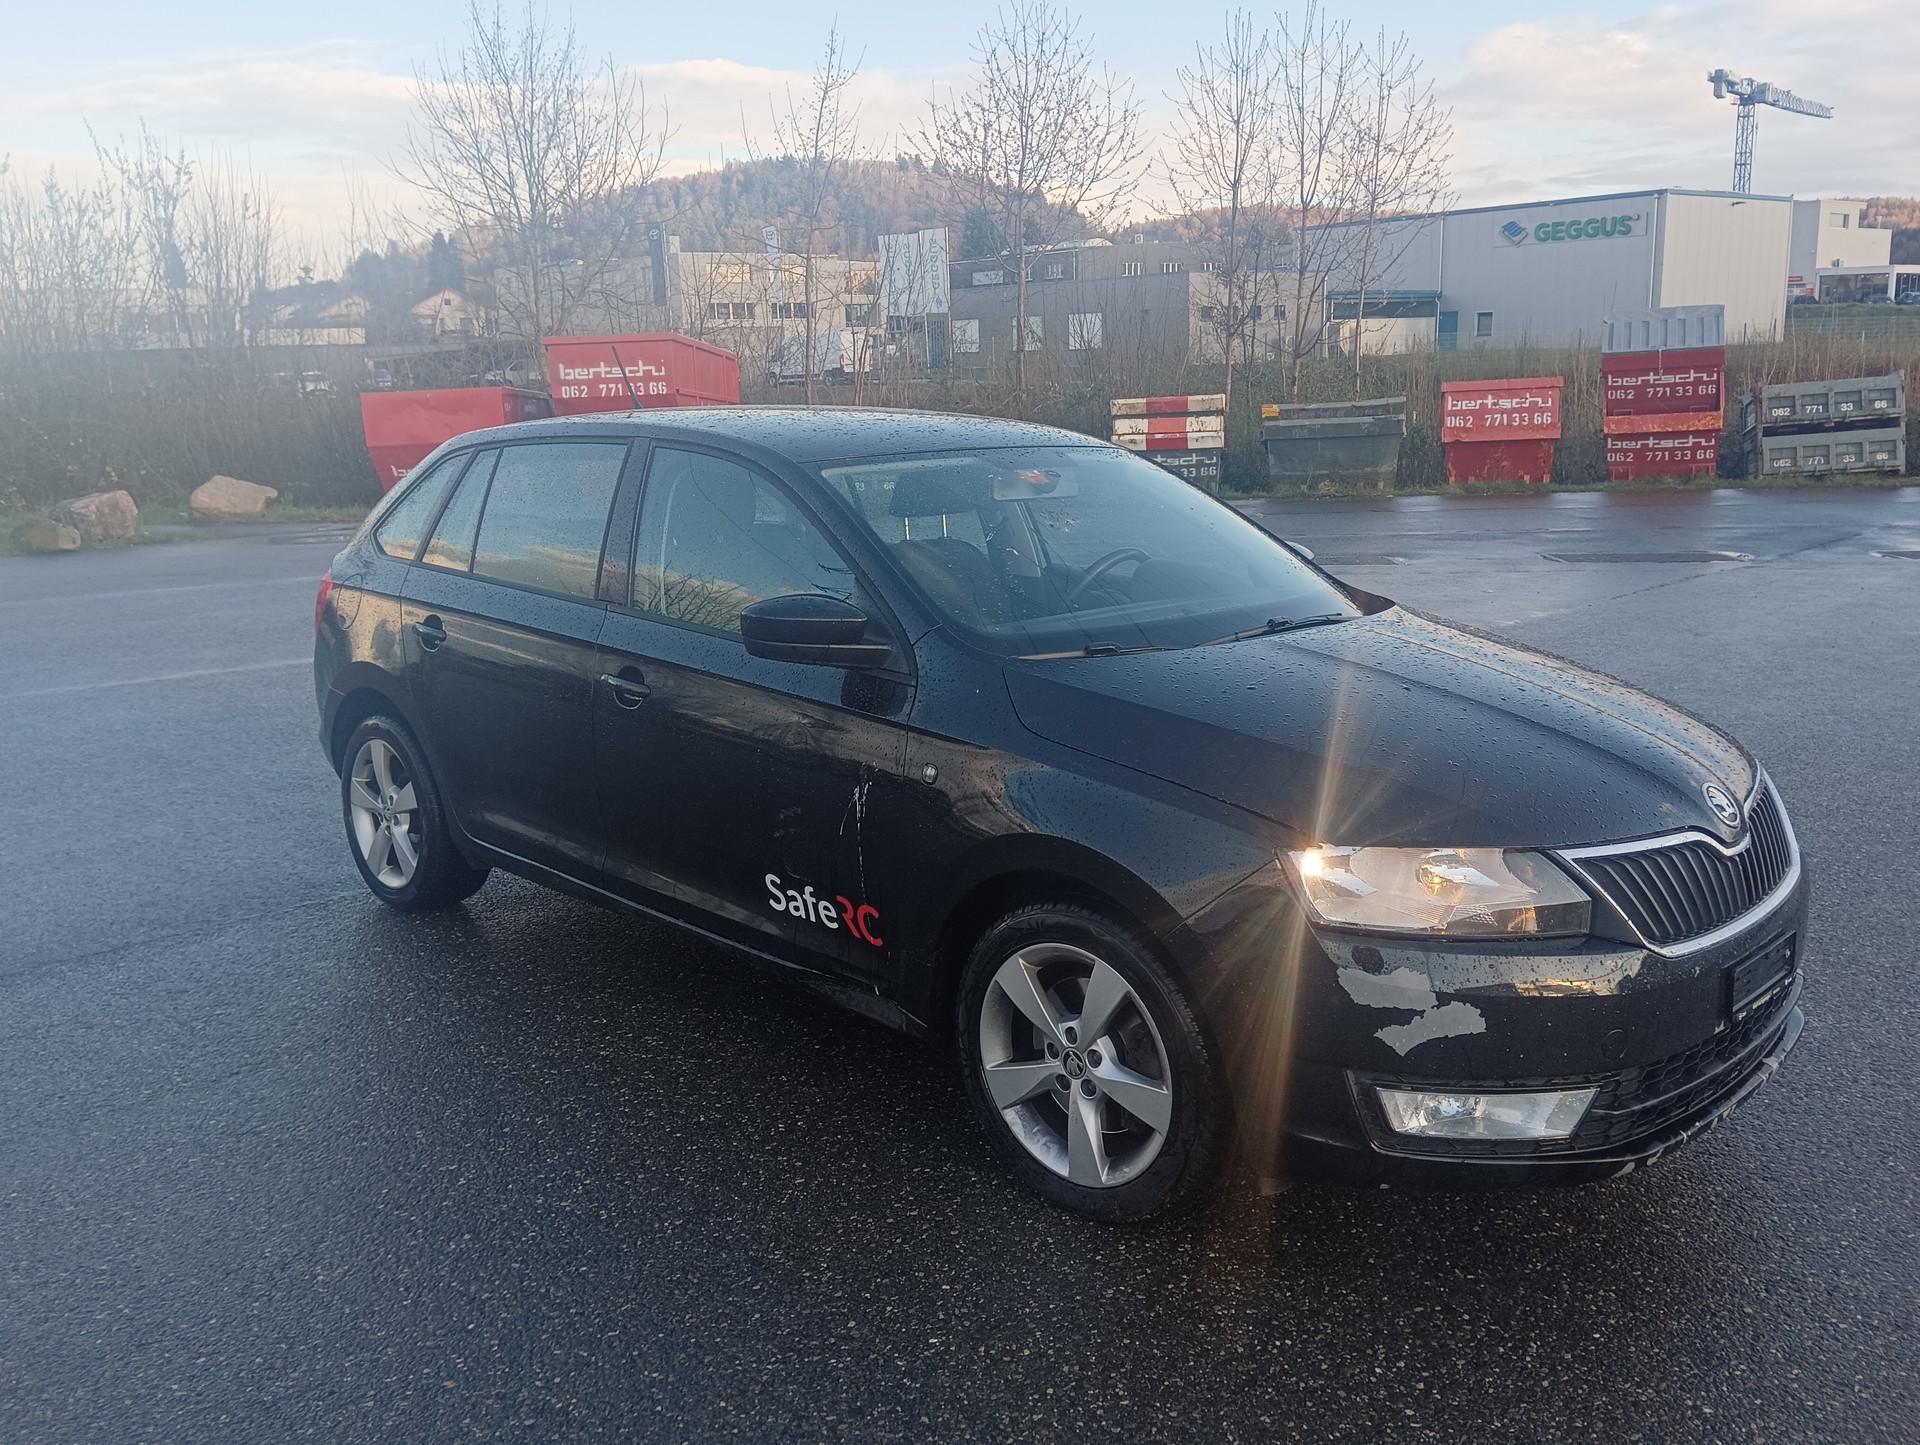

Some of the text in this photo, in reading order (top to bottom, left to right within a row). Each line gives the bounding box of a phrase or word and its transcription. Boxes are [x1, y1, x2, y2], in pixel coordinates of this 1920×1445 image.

[1534, 215, 1633, 242] GEGGUS
[559, 359, 665, 380] bertschi
[1607, 368, 1718, 386] bertschi
[562, 385, 588, 398] 062
[599, 383, 623, 397] 771
[649, 381, 667, 395] 66
[1608, 385, 1717, 399] 062 771 33 66
[1447, 391, 1552, 410] bertschi
[1771, 400, 1888, 417] 062 771 33 66
[1446, 412, 1552, 428] 062 771 33 66
[1607, 433, 1716, 449] bertschi
[1153, 451, 1217, 466] tschi
[1607, 449, 1715, 462] 062 771 33 66
[1773, 451, 1889, 467] 062 771 33 66
[1200, 466, 1217, 476] 66
[764, 873, 884, 947] SafeRC
